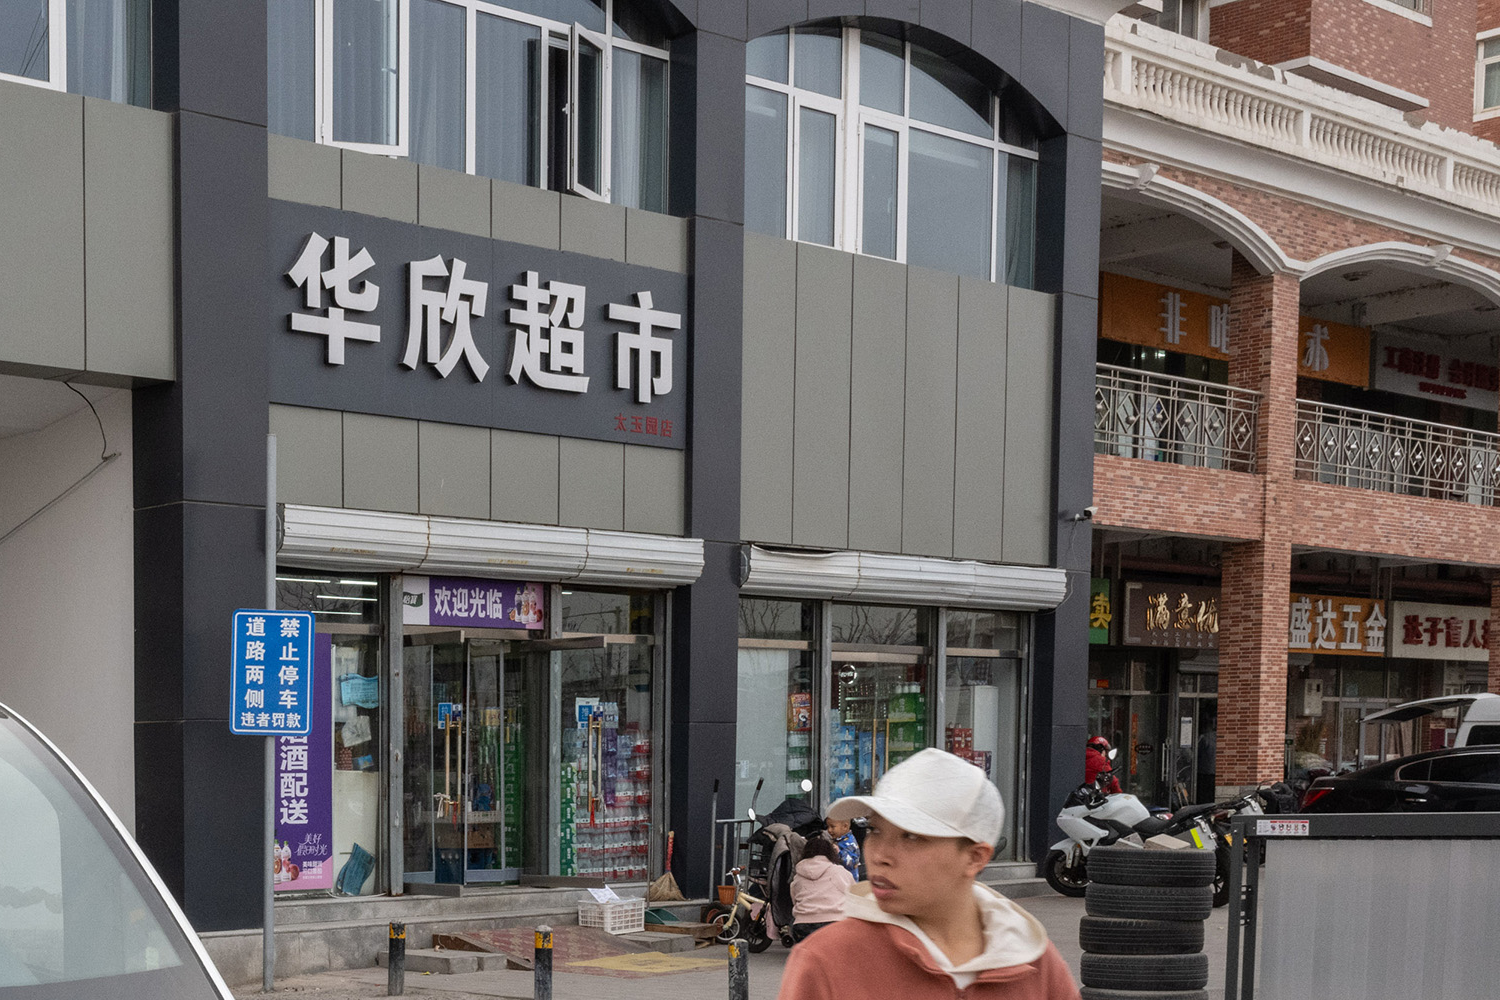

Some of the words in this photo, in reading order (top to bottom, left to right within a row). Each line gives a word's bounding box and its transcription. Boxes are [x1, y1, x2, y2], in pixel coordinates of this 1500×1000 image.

[285, 231, 682, 404] 华欣超市
[614, 413, 674, 438] 太玉园店
[434, 586, 503, 620] 欢迎光临
[1289, 596, 1387, 653] 盛达五金
[244, 616, 266, 709] 道路两侧
[278, 618, 301, 709] 禁止停车
[241, 712, 301, 728] 违者罚款
